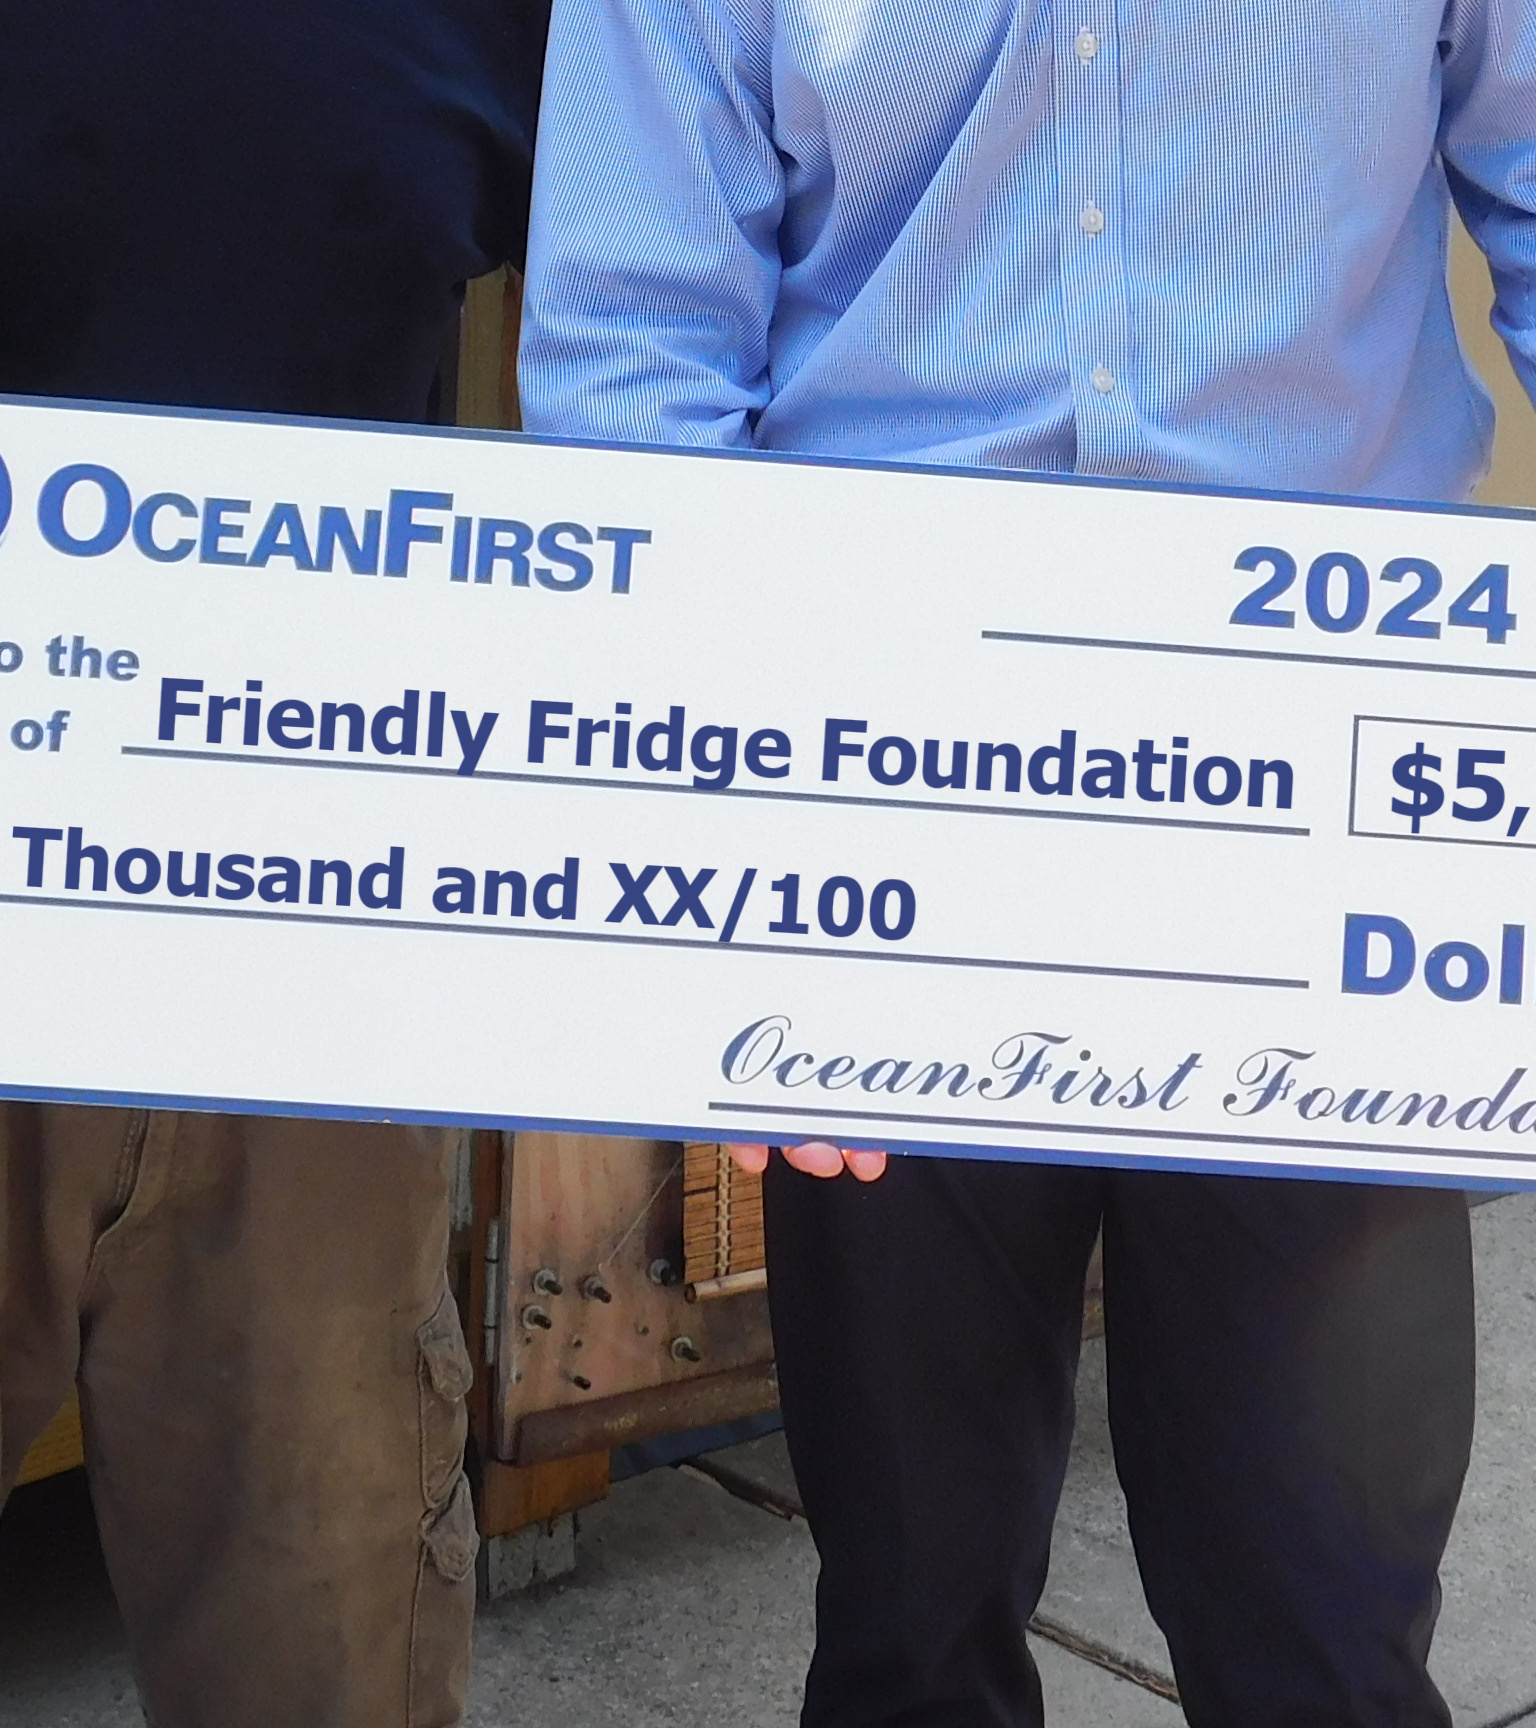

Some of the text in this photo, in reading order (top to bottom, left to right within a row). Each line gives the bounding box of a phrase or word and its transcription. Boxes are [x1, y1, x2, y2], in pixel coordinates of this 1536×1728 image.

[1229, 546, 1517, 645] 2024
[46, 634, 140, 682] the
[10, 709, 71, 752] of
[157, 677, 1294, 810] Friendly Fridge Foundation
[13, 825, 405, 911] Thousand
[433, 856, 580, 921] and
[604, 863, 917, 941] XX/100
[720, 1015, 1203, 1112] OceanFirst
